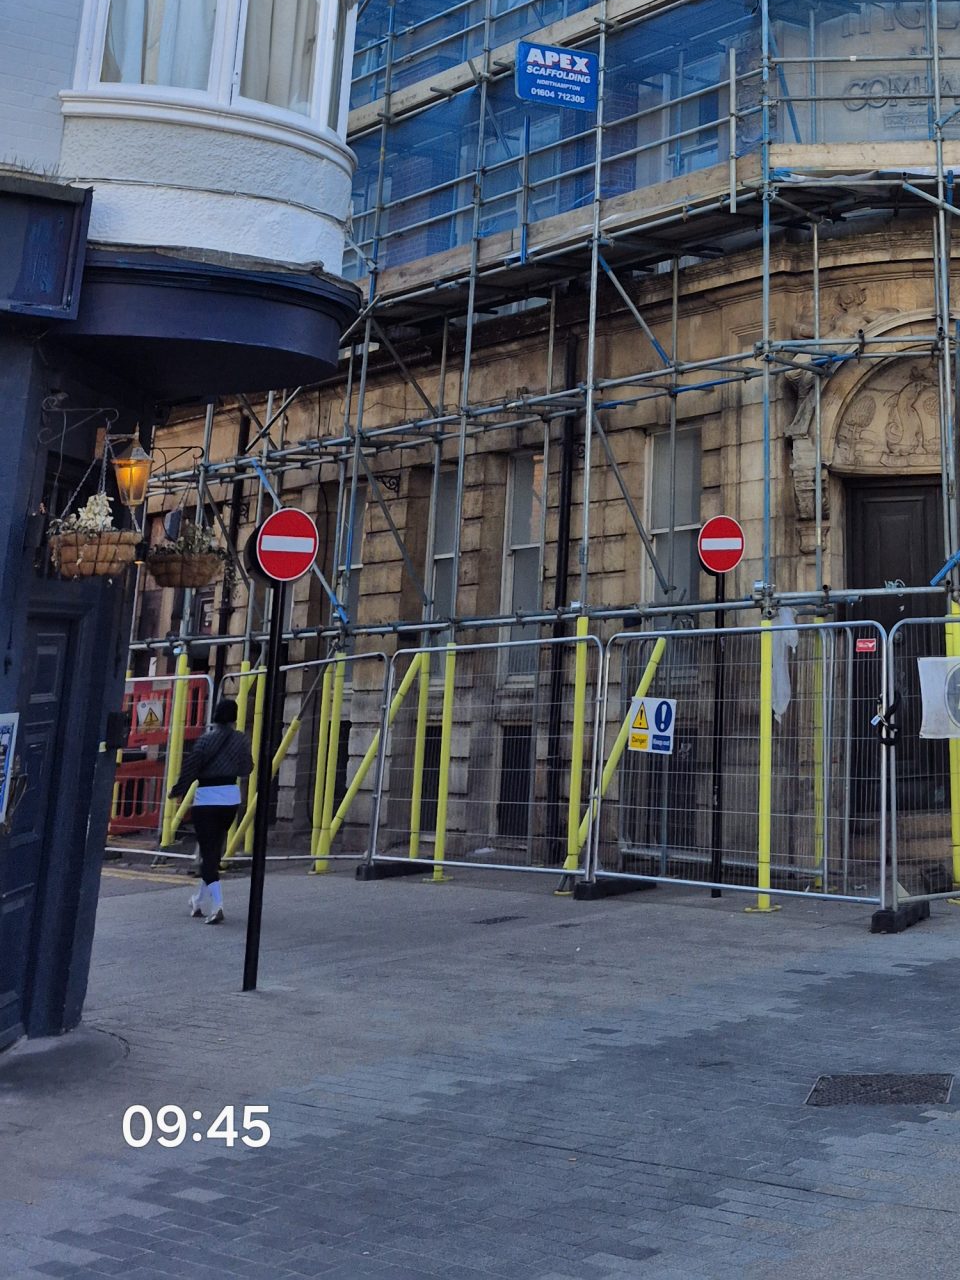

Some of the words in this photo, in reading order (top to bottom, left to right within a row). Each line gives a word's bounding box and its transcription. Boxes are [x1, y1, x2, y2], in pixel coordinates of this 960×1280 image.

[526, 48, 589, 73] APEX
[526, 65, 591, 84] SCAFFOLDING
[531, 88, 555, 98] 01604
[557, 92, 585, 104] 712305
